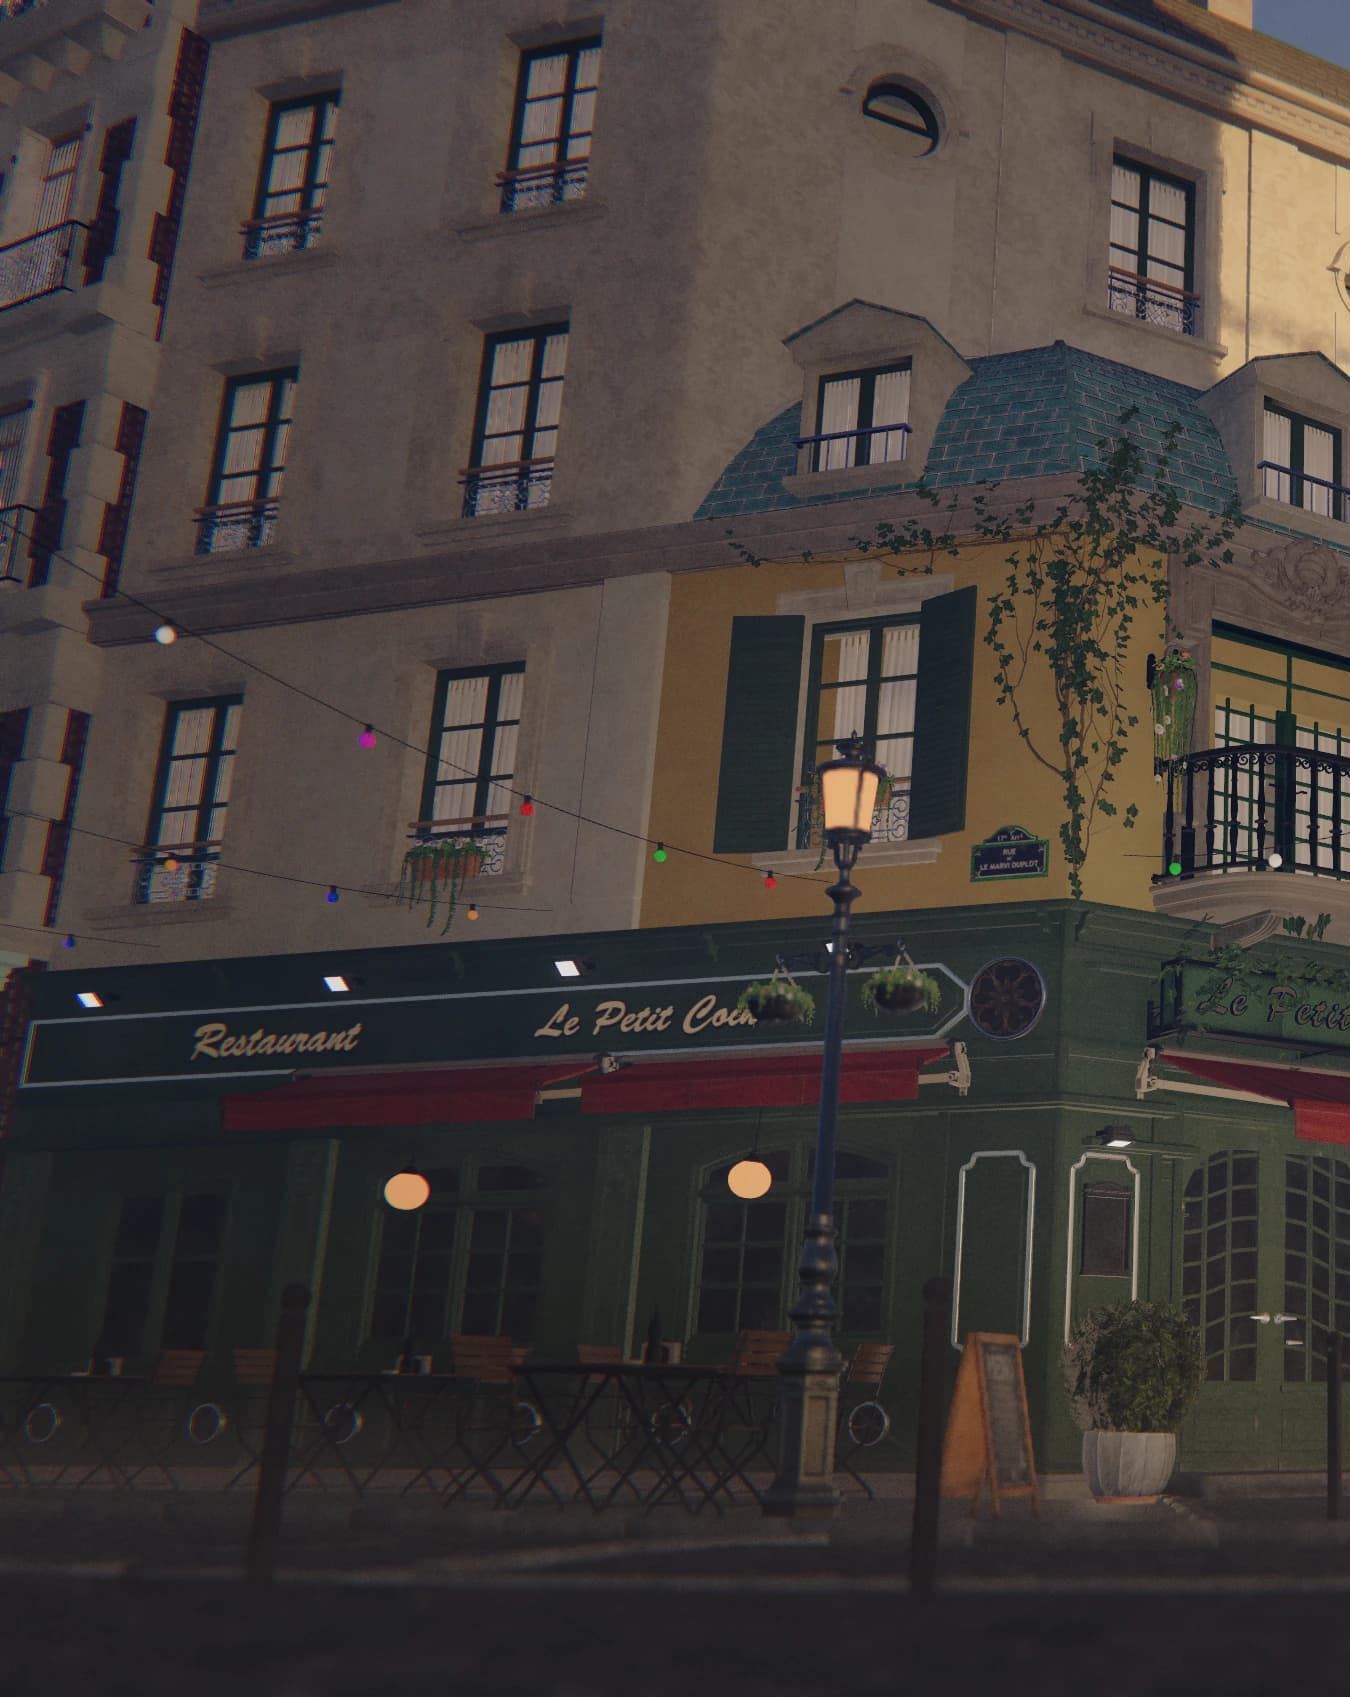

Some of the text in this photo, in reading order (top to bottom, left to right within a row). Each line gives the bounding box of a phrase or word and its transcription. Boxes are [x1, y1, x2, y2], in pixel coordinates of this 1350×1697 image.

[1002, 847, 1017, 856] RUE
[1197, 976, 1249, 1017] Le
[535, 1003, 580, 1038] Le
[593, 1000, 674, 1036] Petit
[190, 1022, 364, 1061] Restaurant
